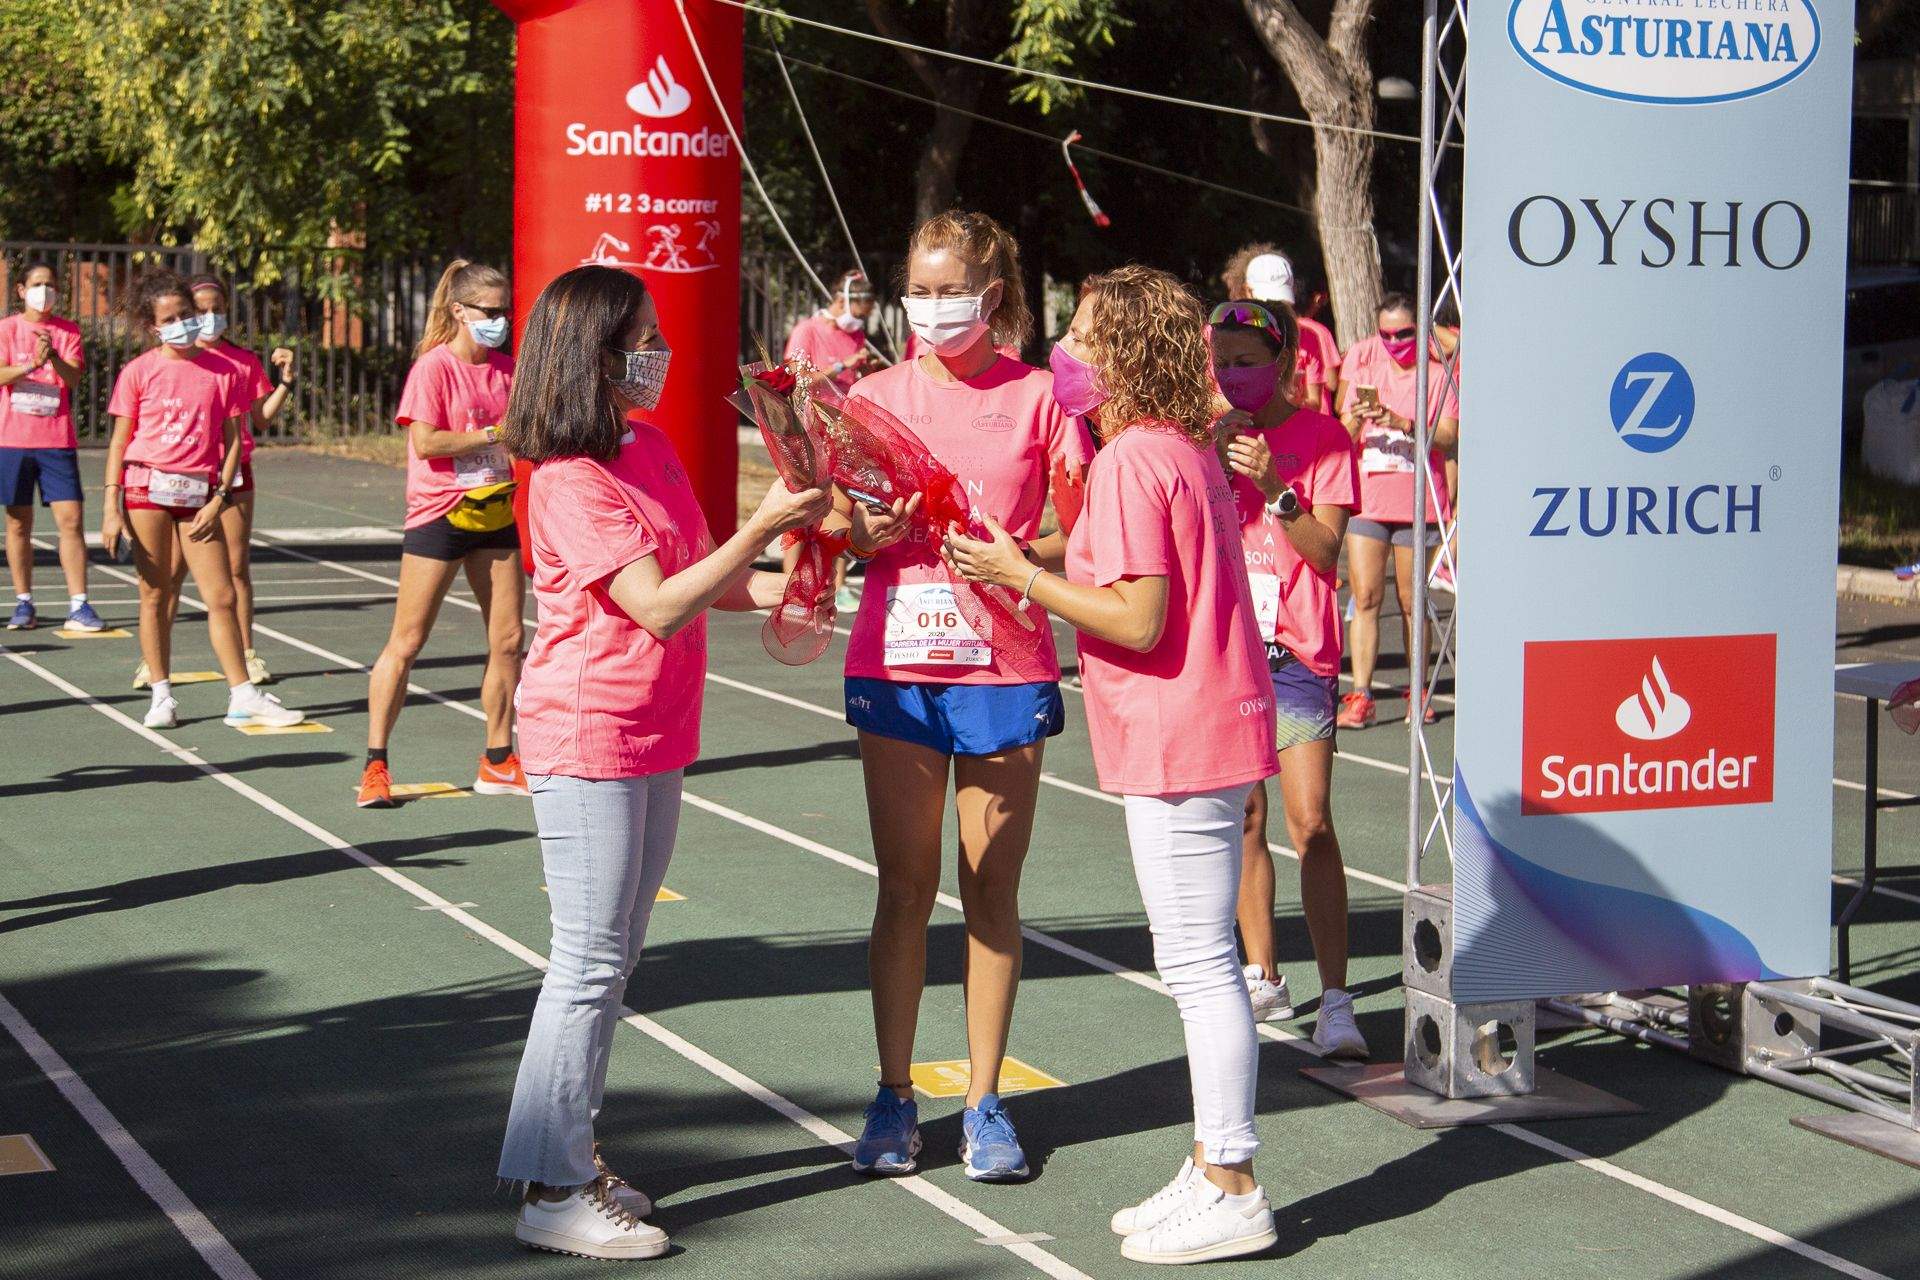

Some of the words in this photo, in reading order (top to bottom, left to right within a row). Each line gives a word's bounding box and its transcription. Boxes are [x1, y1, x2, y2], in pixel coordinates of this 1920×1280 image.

[1532, 0, 1798, 62] ASTURIANA
[566, 122, 731, 157] Santander
[1508, 195, 1811, 270] OYSHO
[1529, 484, 1762, 537] ZURICH
[1245, 551, 1275, 565] SON
[917, 612, 957, 628] 016
[1540, 748, 1757, 798] Santander
